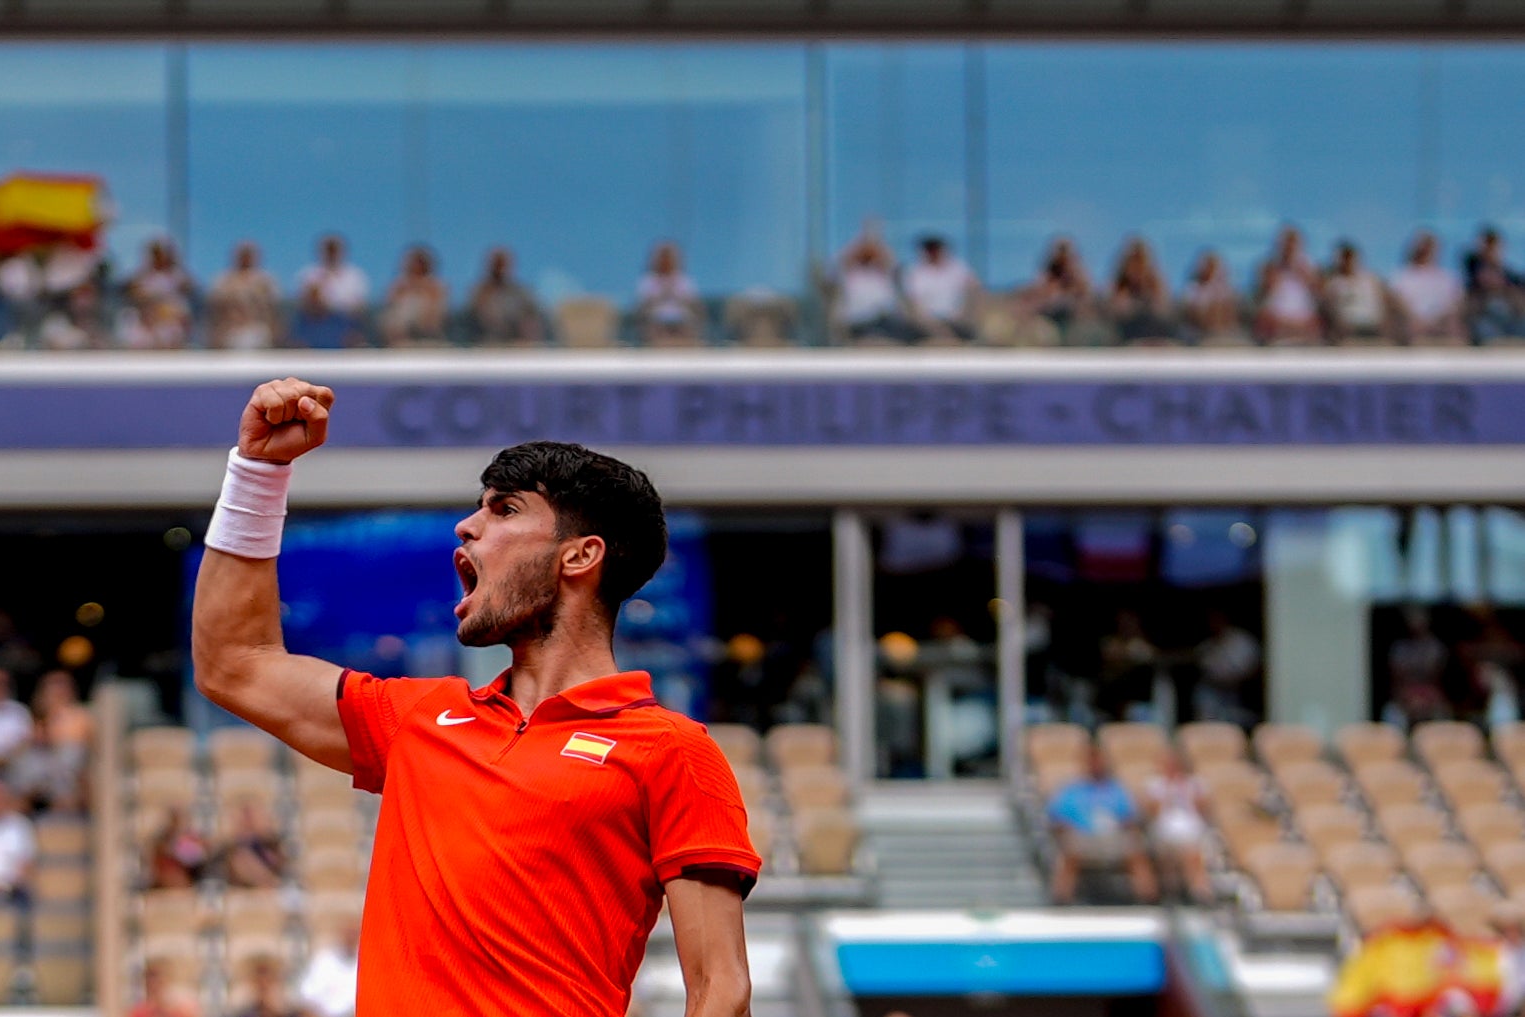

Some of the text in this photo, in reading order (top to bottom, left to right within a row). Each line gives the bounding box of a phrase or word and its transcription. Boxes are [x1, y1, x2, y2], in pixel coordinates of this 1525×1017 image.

[383, 382, 650, 443] COURT
[677, 382, 1020, 443] PHILIPPE
[1093, 382, 1473, 441] CHATRIER
